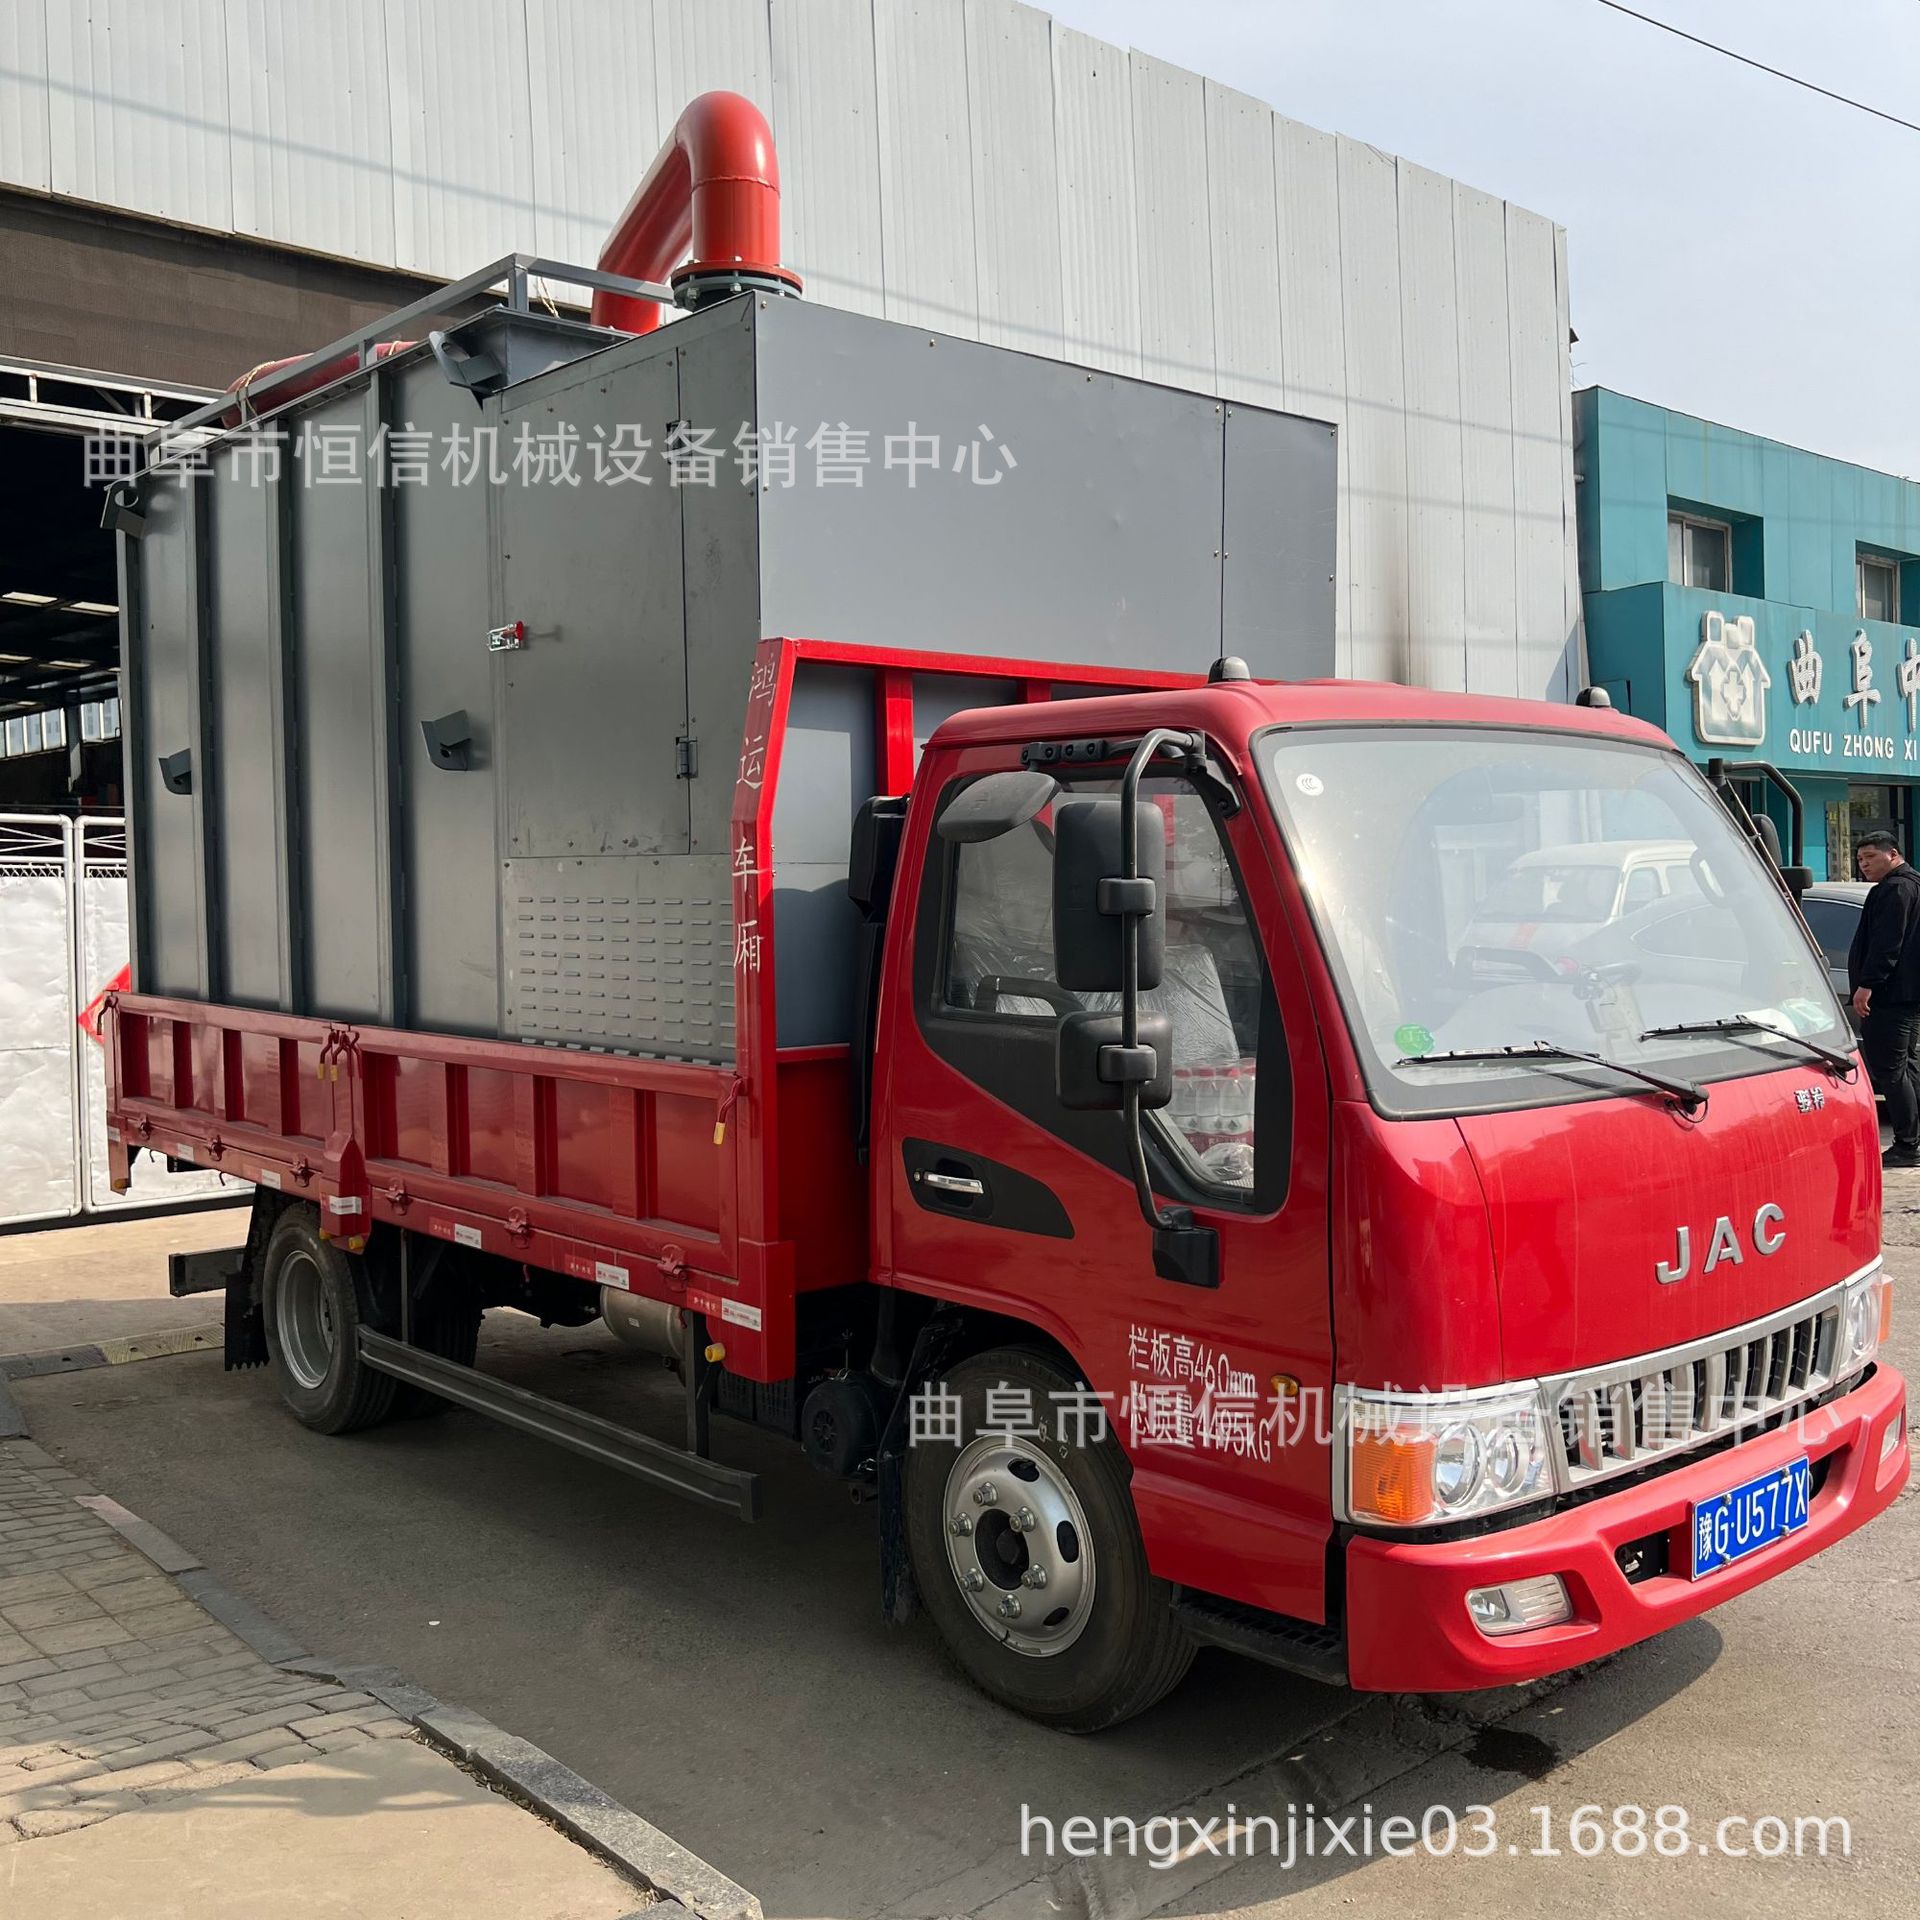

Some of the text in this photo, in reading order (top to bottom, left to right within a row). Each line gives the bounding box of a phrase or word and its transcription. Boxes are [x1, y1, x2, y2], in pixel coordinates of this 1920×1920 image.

[1789, 728, 1832, 755] QUFU
[1843, 734, 1894, 760] ZHONG
[1655, 1202, 1787, 1285] JAC
